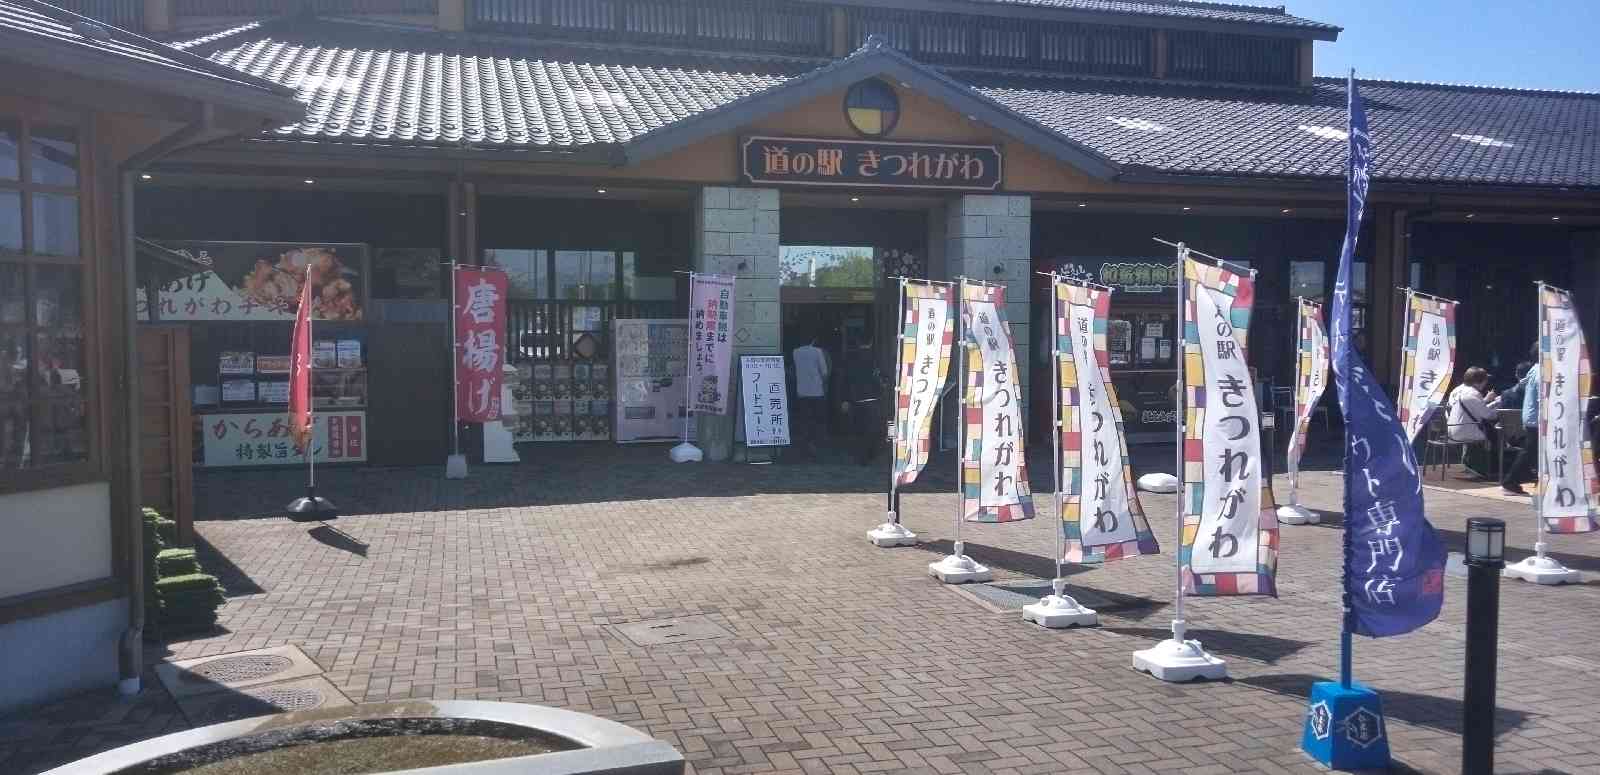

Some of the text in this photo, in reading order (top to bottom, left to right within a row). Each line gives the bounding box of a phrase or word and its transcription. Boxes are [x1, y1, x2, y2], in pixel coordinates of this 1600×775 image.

[763, 145, 985, 180] 道の駅 きつれがわ
[717, 289, 730, 344] 自動車税は
[926, 308, 936, 345] 道の駅
[1426, 323, 1441, 361] 道の駅
[462, 278, 500, 416] 唐揚げ
[751, 372, 764, 436] フードコート
[769, 382, 783, 425] 直売所
[978, 310, 1015, 497] 道の駅 きつれがわ
[1552, 319, 1576, 508] 道の駅 きつれがわ
[1208, 374, 1250, 559] きつれがわ
